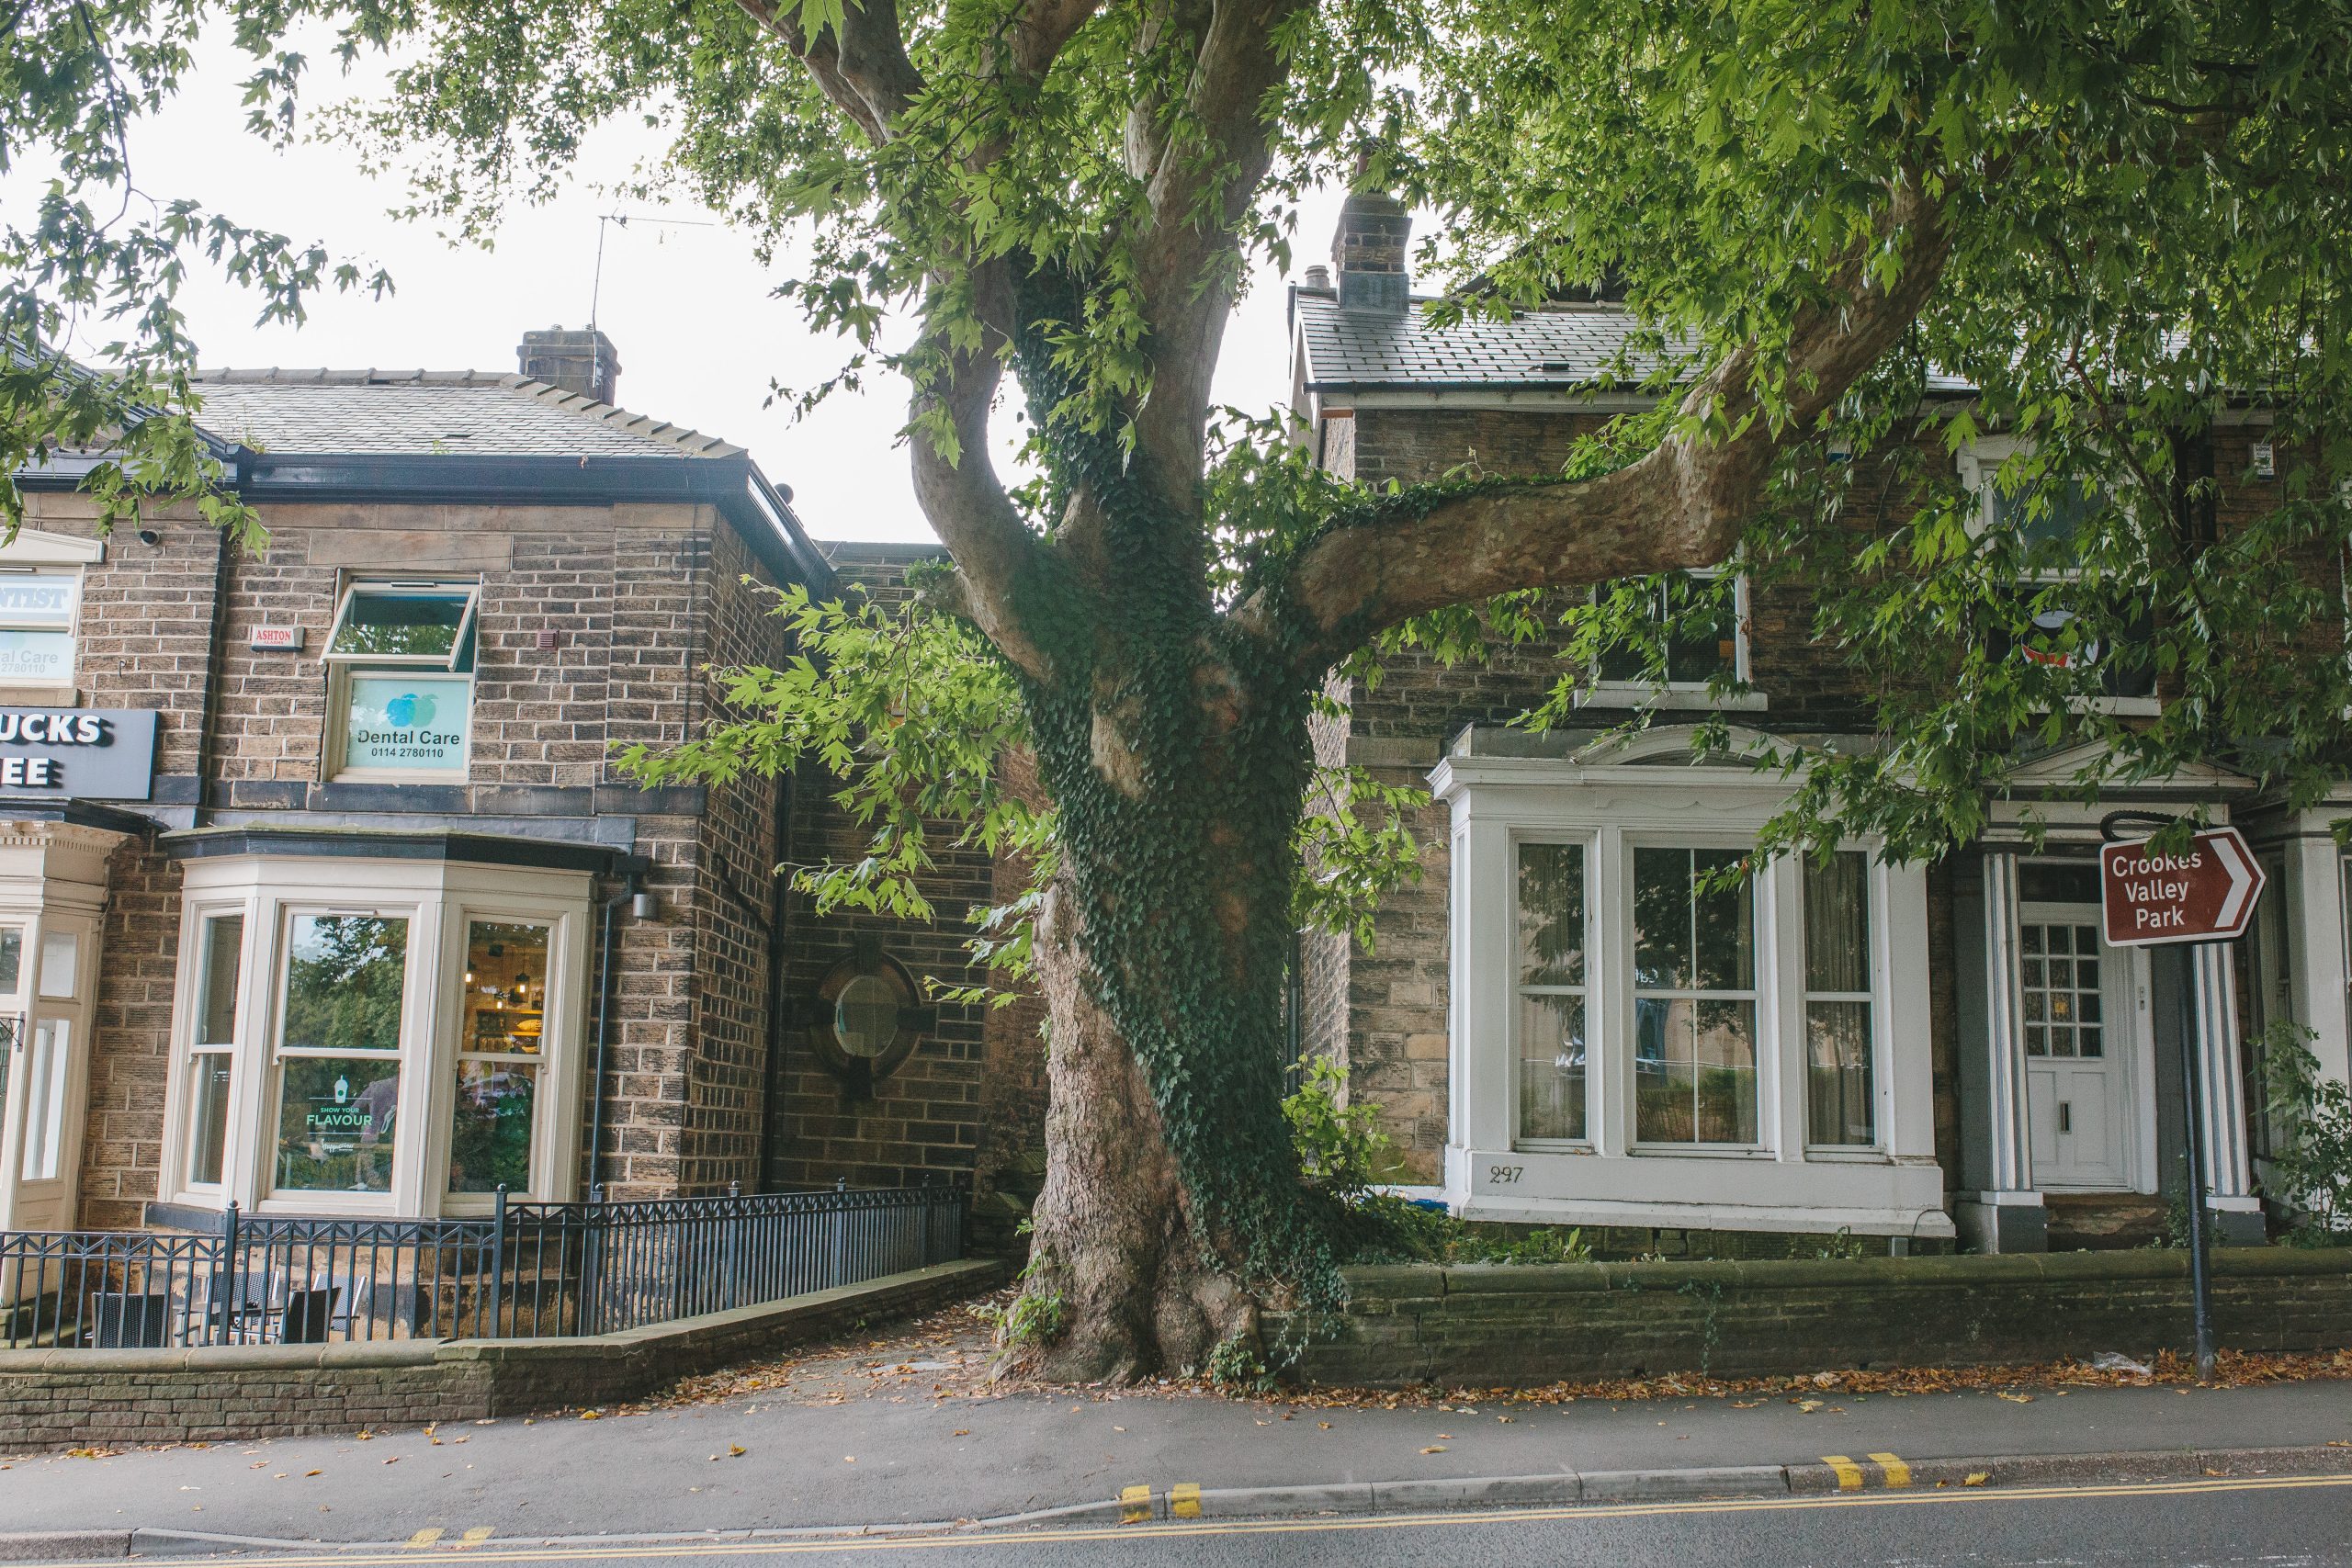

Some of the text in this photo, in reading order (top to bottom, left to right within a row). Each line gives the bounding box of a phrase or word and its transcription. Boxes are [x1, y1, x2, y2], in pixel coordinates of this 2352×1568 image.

[256, 629, 291, 640] ASHTON
[20, 649, 59, 663] Care
[1, 663, 45, 673] 2780110
[0, 713, 101, 743] UCKS
[357, 729, 460, 745] Dental Care
[371, 748, 444, 758] 0114 2780110
[1, 757, 50, 784] EE
[2113, 852, 2202, 877] Crookes
[2125, 879, 2188, 903] Valley
[2136, 906, 2185, 930] Park
[306, 1114, 373, 1126] FLAVOUR
[1489, 1166, 1524, 1184] 297
